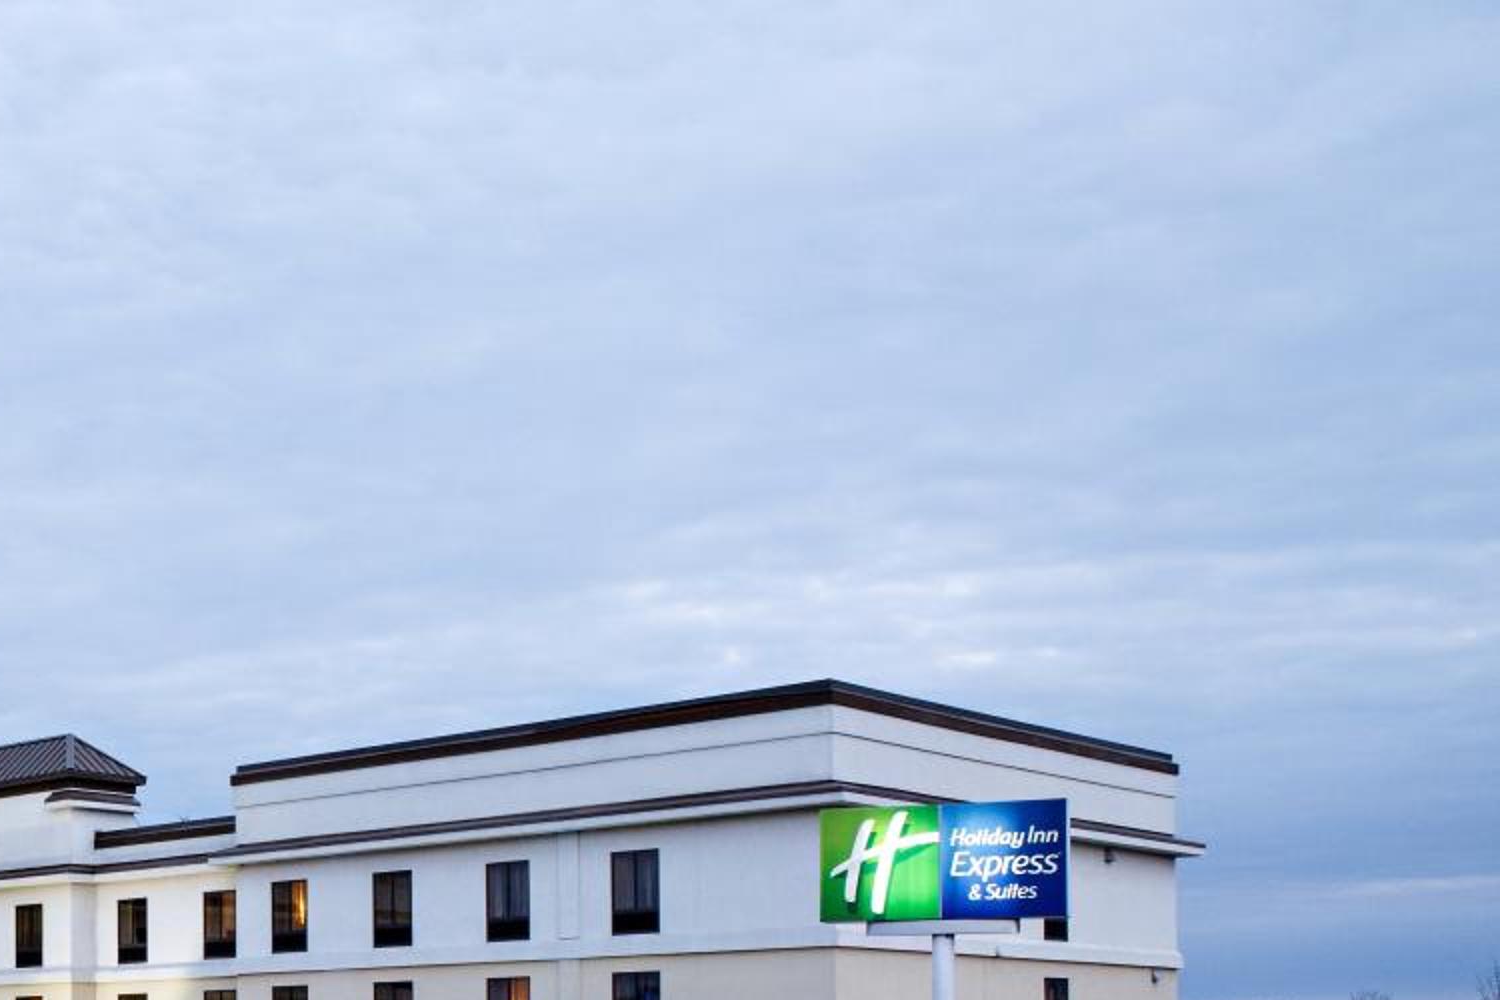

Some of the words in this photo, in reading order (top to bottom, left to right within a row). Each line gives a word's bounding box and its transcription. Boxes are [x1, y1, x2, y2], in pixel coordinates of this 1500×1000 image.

[950, 826, 1025, 848] Holiday
[1027, 824, 1059, 844] Inn
[950, 851, 1059, 882] Express
[968, 883, 982, 901] &
[984, 883, 1038, 900] Suites
